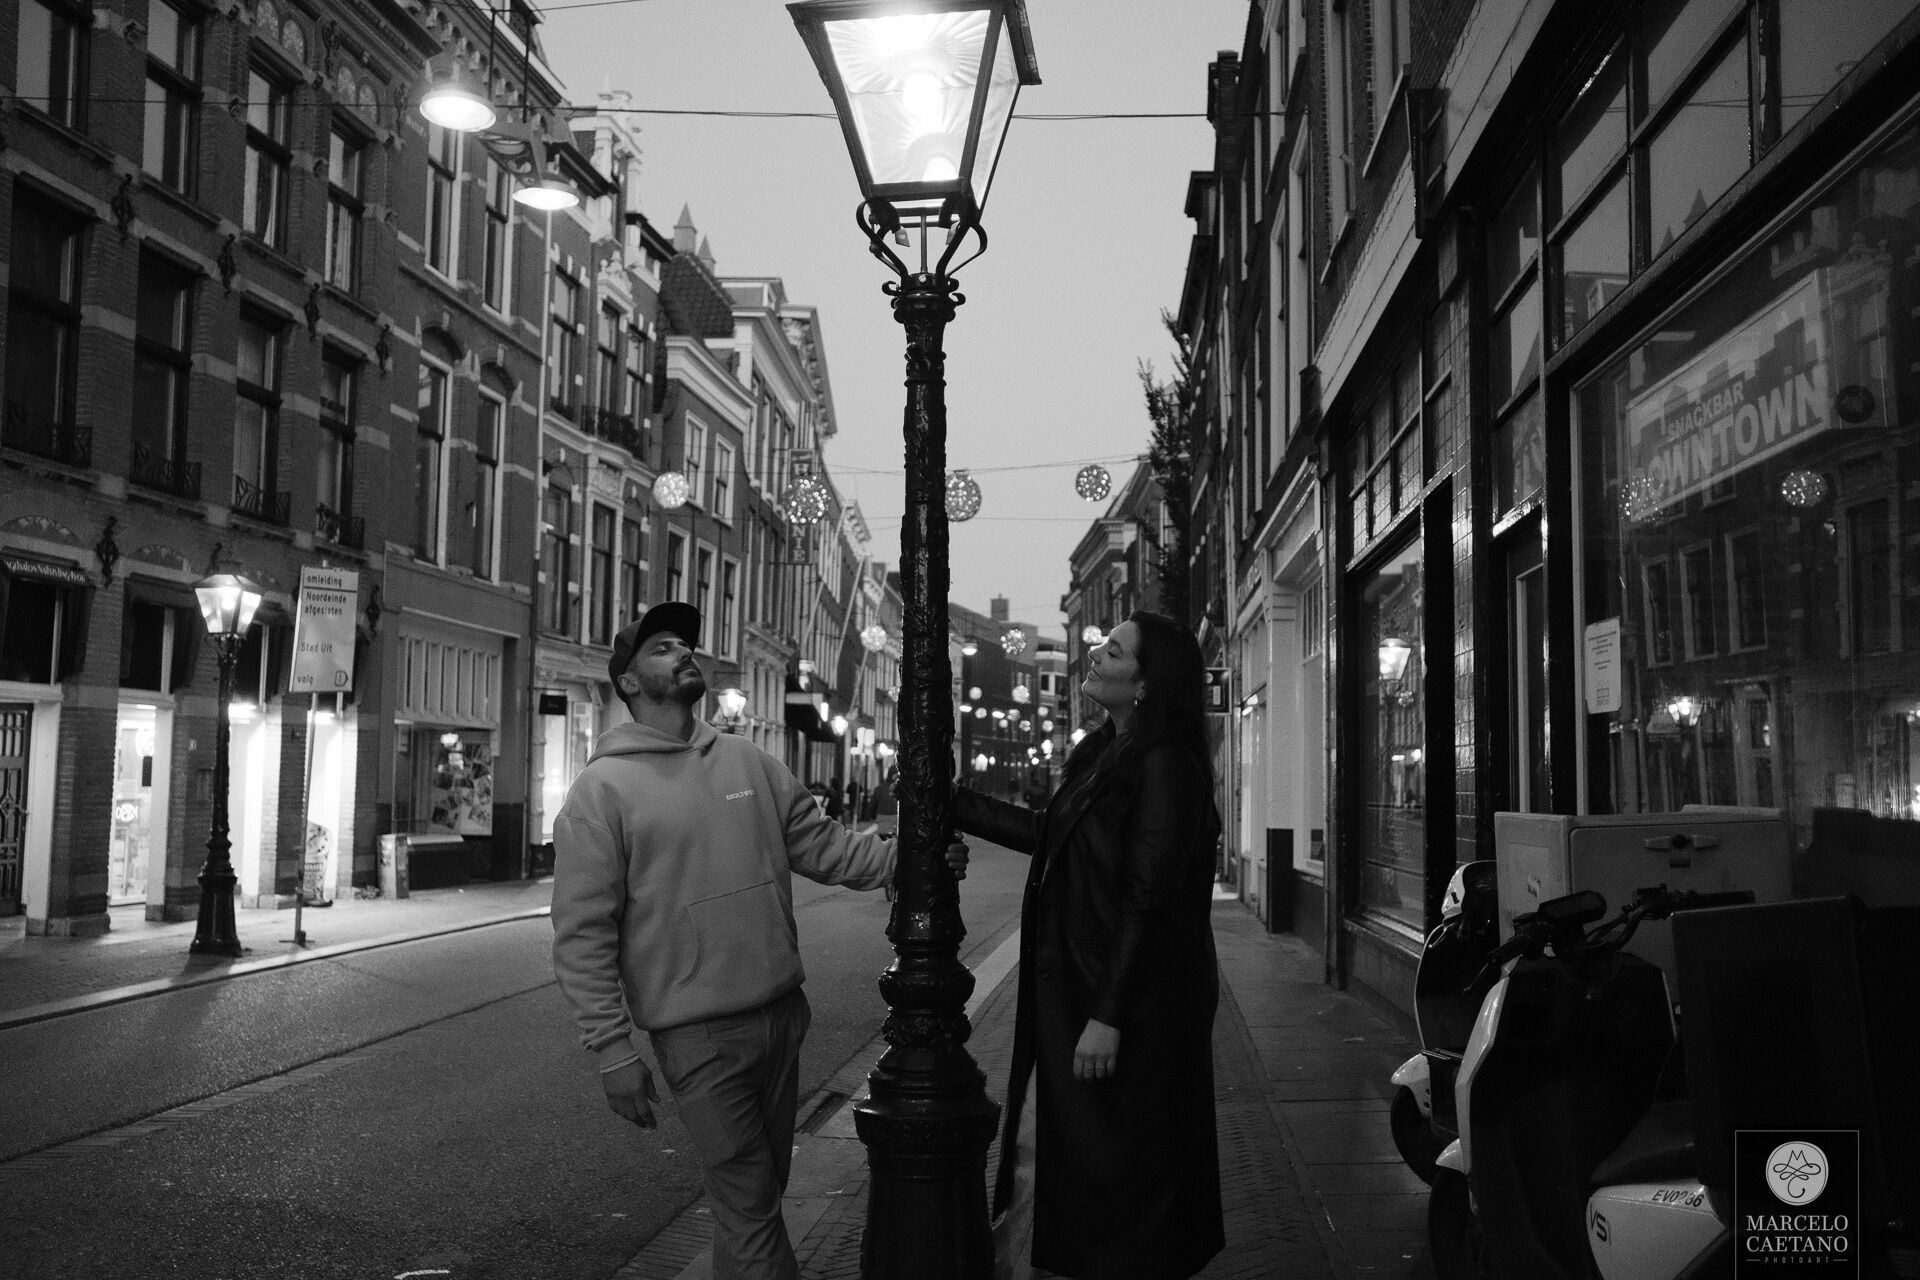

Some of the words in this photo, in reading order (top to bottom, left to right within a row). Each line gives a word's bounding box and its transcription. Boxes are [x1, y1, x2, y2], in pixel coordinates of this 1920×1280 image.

[1667, 380, 1744, 441] SNACKBAR
[307, 574, 342, 588] omleiding
[306, 591, 347, 604] Noordeinde
[304, 605, 343, 617] afgesloten
[301, 642, 319, 652] Stad
[298, 674, 314, 686] volg
